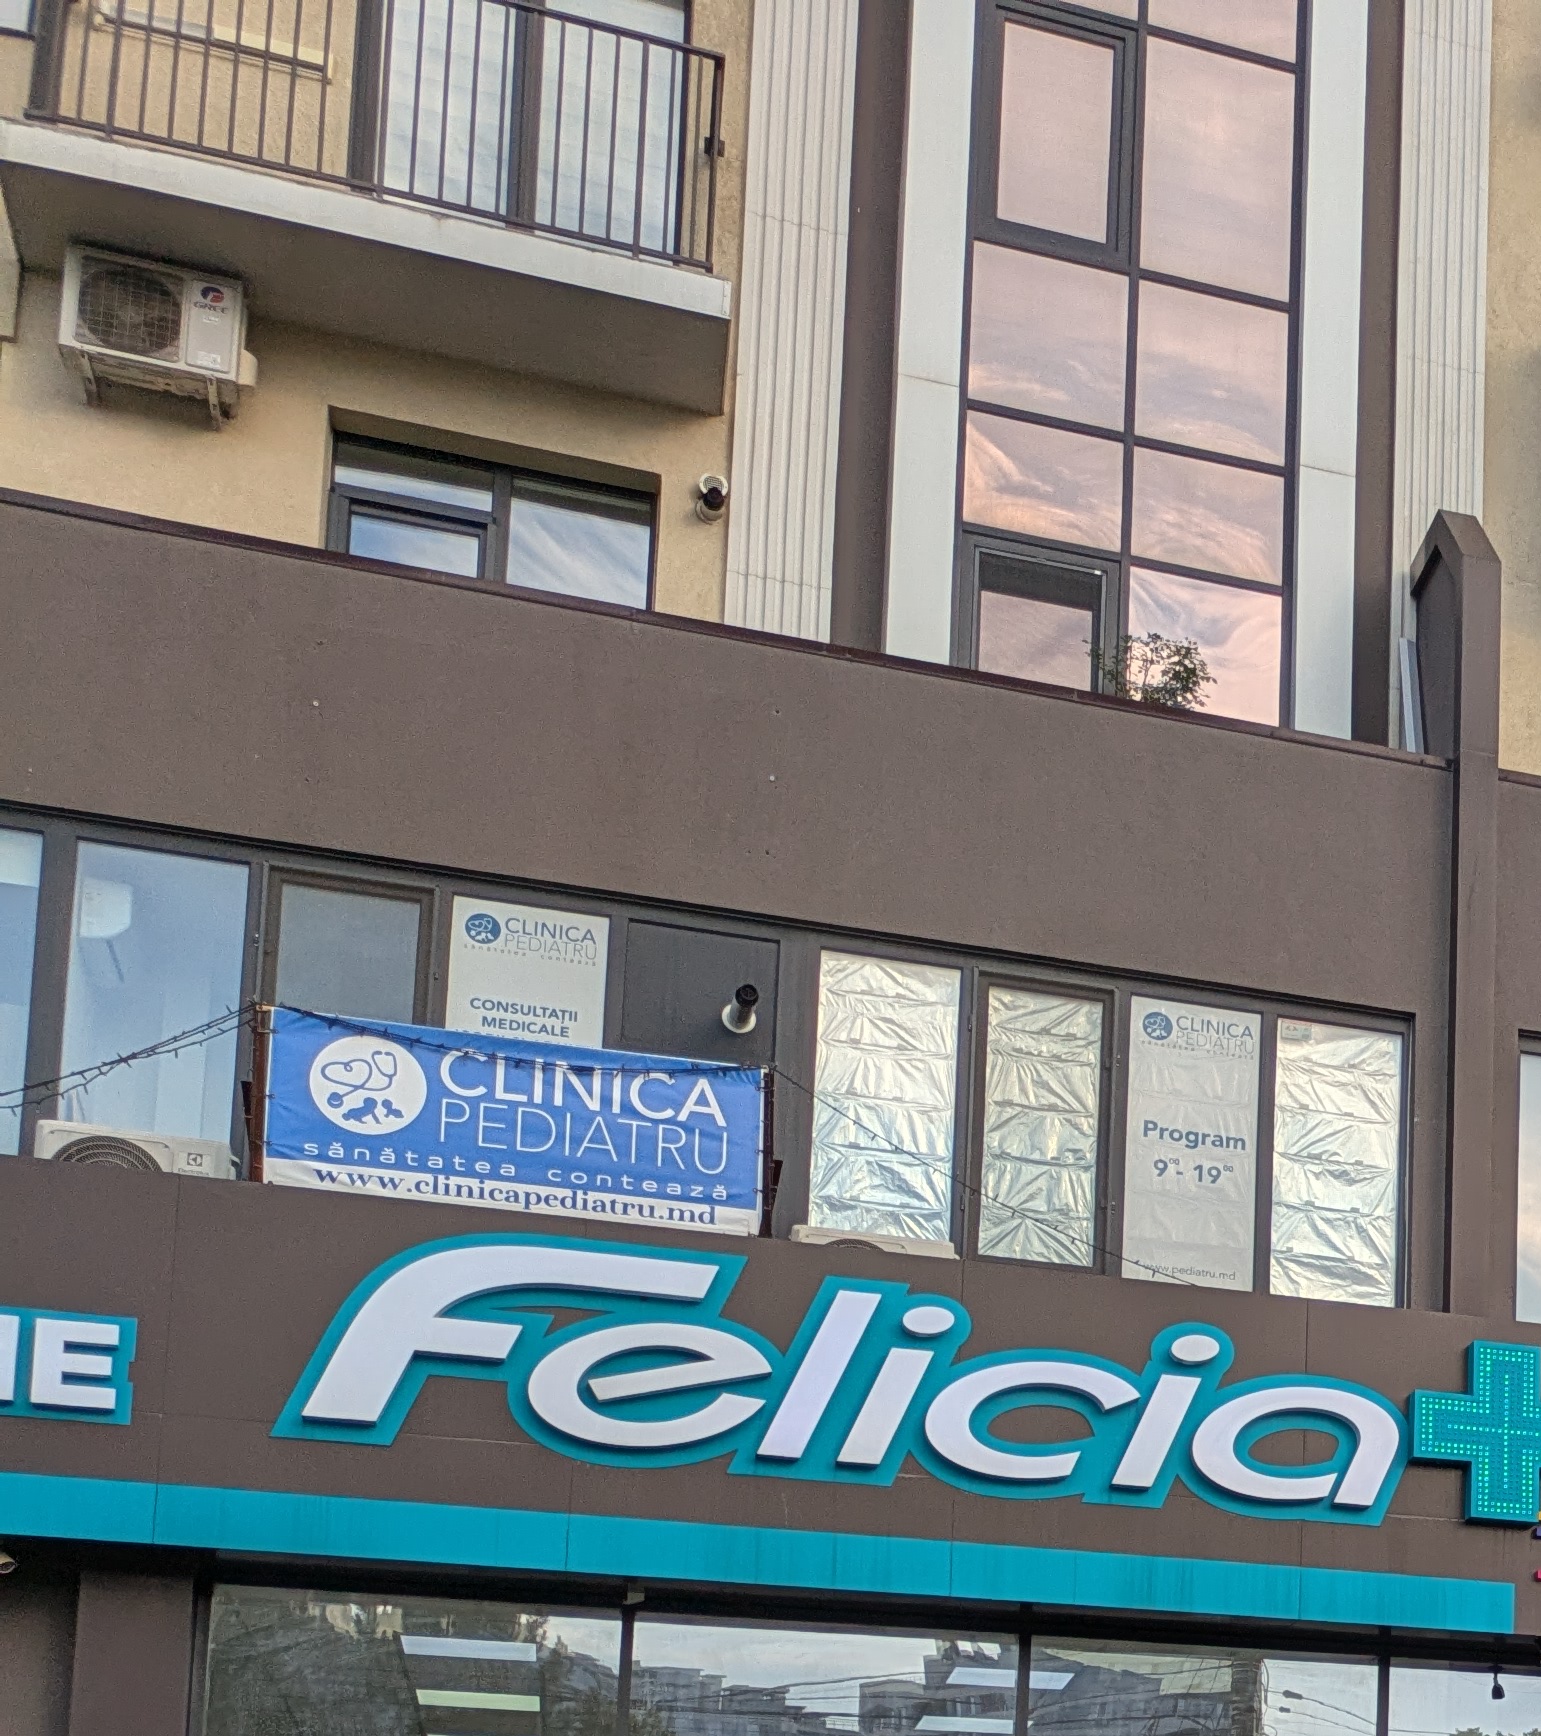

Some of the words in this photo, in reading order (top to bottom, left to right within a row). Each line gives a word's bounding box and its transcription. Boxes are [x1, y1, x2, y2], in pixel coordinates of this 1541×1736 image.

[505, 918, 596, 945] CLINICA
[504, 933, 597, 960] PEDIATRU
[470, 998, 578, 1024] CONSULTAȚII
[482, 1016, 570, 1038] MEDICALE
[1176, 1015, 1254, 1040] CLINICA
[1176, 1031, 1255, 1054] PEDIATRU
[440, 1049, 727, 1127] CLINICA
[440, 1099, 728, 1174] PEDIATRU
[1143, 1120, 1246, 1150] Program
[303, 1140, 516, 1177] sănătatea
[547, 1167, 728, 1201] contează
[312, 1168, 718, 1226] www.clinicapediatru.md
[1142, 1262, 1236, 1281] www.pediatru.md
[302, 1243, 1400, 1510] Felicia
